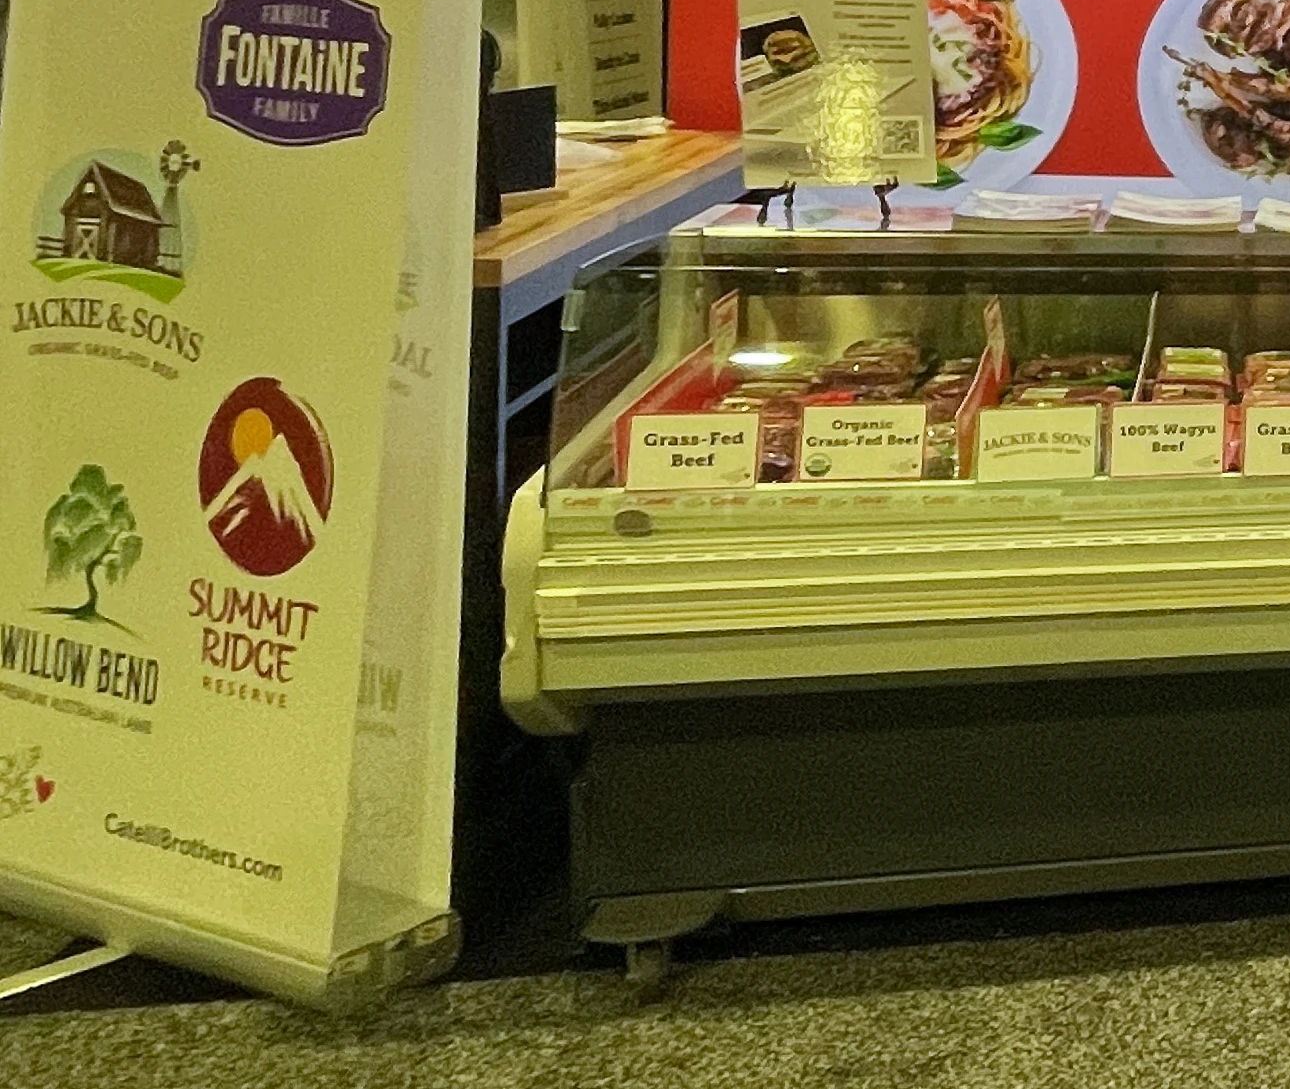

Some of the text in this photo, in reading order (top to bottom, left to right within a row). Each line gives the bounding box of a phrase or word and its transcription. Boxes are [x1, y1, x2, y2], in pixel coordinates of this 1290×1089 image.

[253, 97, 320, 123] FAMILY
[12, 298, 204, 363] JACKIE & SONS
[831, 419, 894, 433] Organic
[1119, 422, 1217, 440] 100% Wagyu
[643, 430, 744, 448] Grass-Fed
[806, 434, 920, 448] Grass-Fed Beef
[983, 432, 1092, 451] JACKIE & SONS
[1151, 440, 1186, 453] Beef
[670, 452, 715, 468] Beef
[188, 577, 319, 641] SUMMIT
[0, 623, 160, 705] WILLOW BEND
[202, 627, 298, 684] RIDGE
[202, 675, 288, 709] RESERVE
